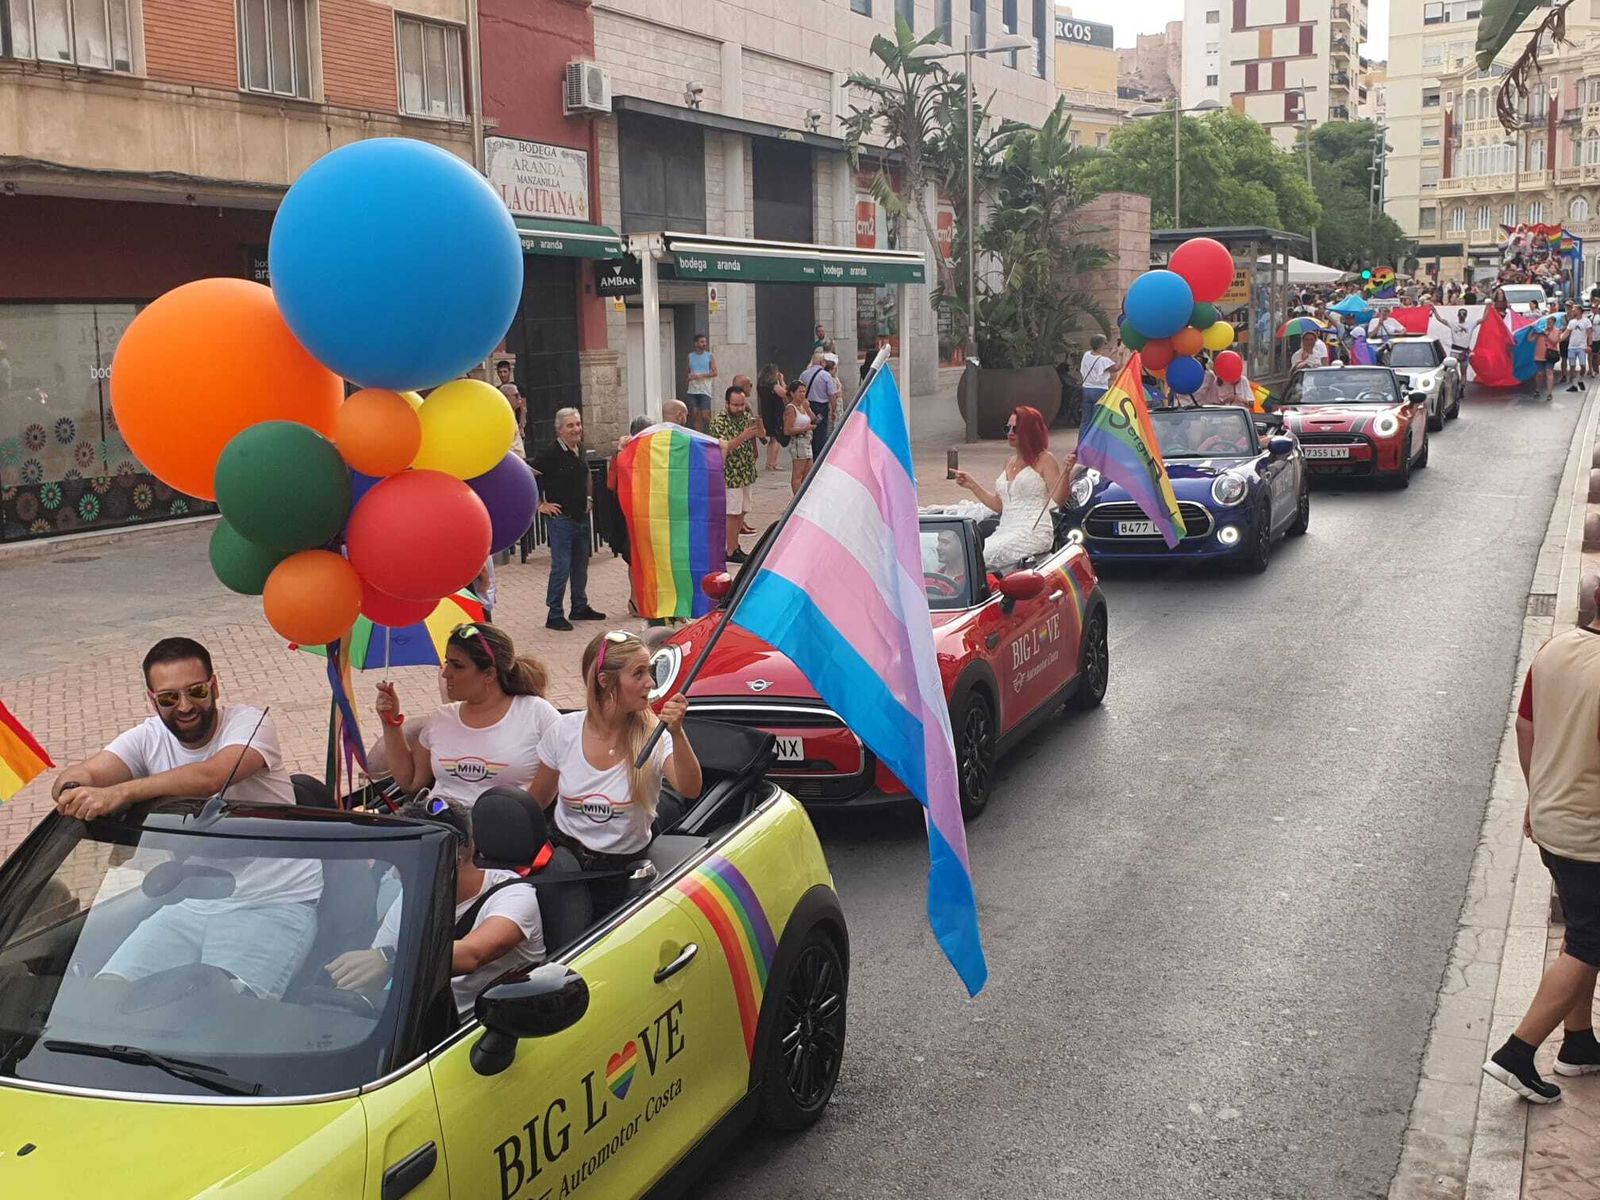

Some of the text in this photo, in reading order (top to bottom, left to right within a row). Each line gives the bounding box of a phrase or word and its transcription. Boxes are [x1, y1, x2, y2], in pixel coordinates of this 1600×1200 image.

[1056, 21, 1091, 41] RCOS
[519, 142, 557, 157] BODEGA
[511, 158, 565, 177] ARANDA
[516, 174, 560, 188] MANZANILLA
[857, 218, 874, 236] cm2
[522, 239, 563, 250] ega aranda
[679, 256, 741, 272] bodega aranda
[823, 264, 844, 277] bodega
[255, 269, 271, 279] ara
[90, 364, 112, 379] bod
[1306, 449, 1347, 457] 7355 LXY
[1121, 523, 1148, 533] 8477
[1011, 633, 1031, 670] BIG
[776, 740, 798, 757] NX
[458, 764, 485, 774] MINI
[584, 803, 610, 814] MINI
[559, 1077, 682, 1200] Automotor Costa
[494, 1097, 571, 1200] BIG
